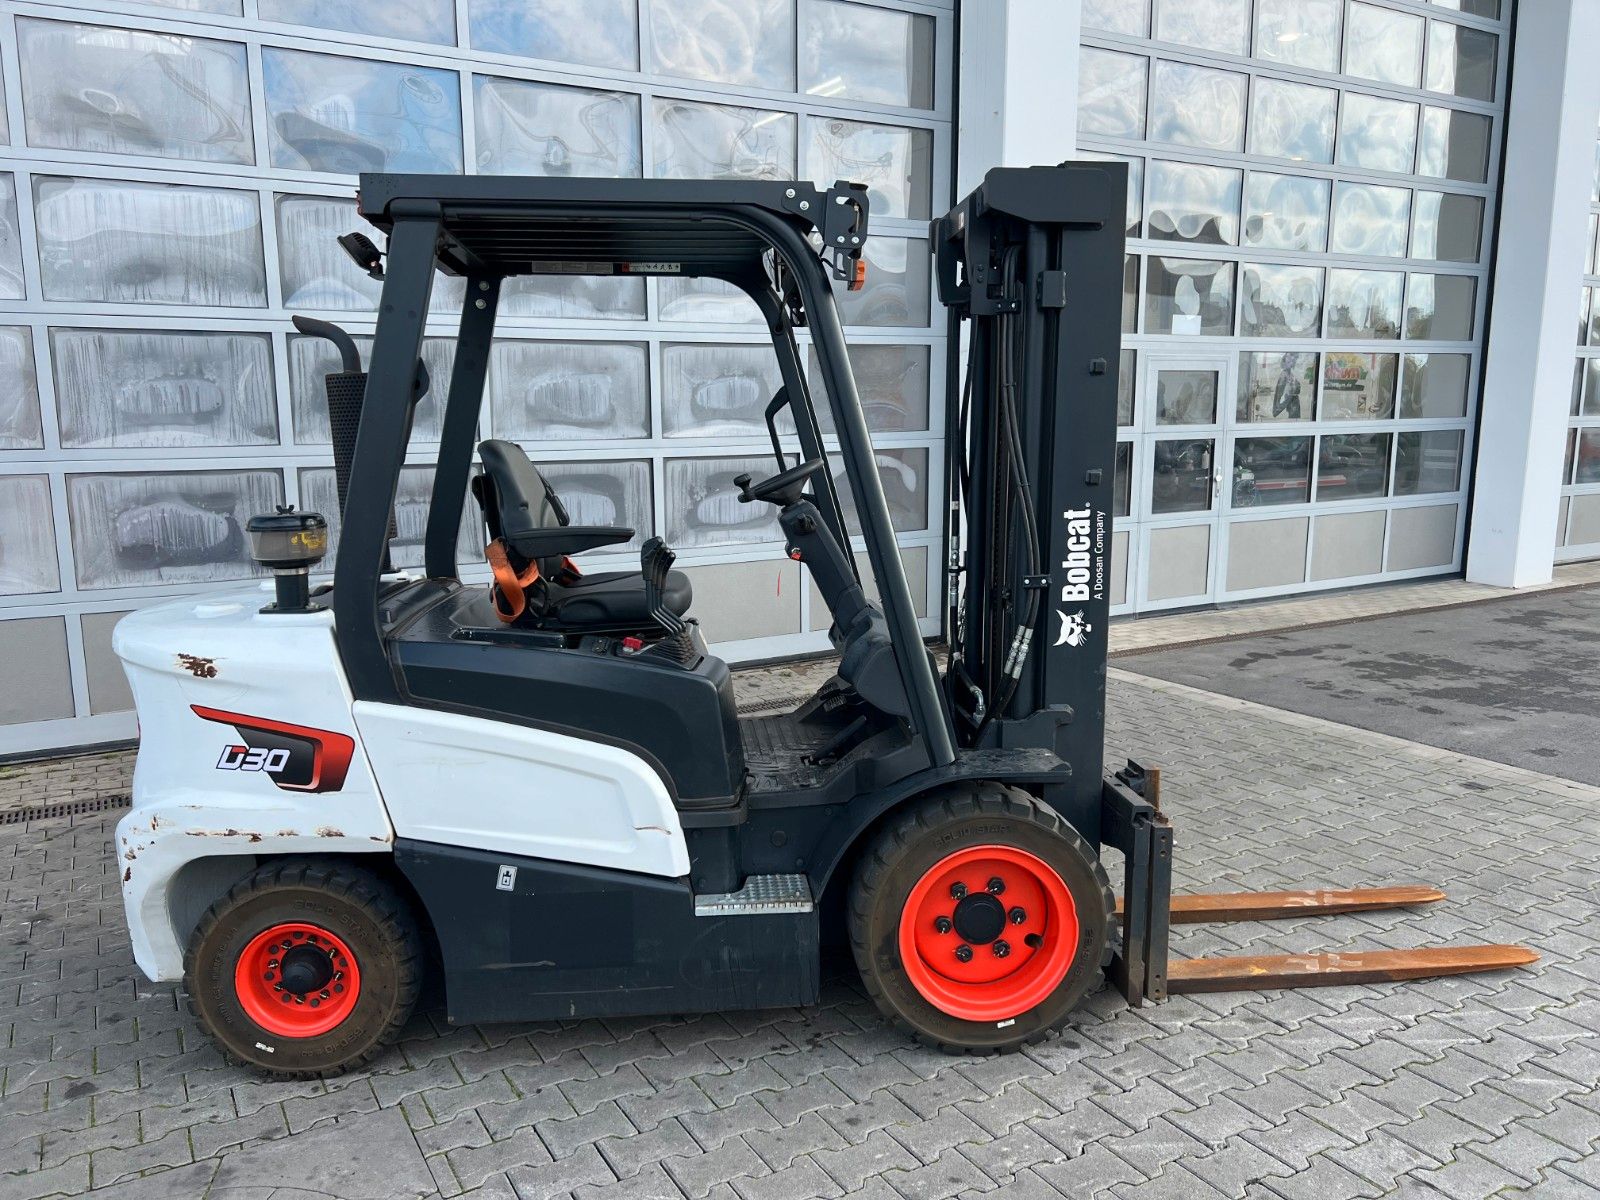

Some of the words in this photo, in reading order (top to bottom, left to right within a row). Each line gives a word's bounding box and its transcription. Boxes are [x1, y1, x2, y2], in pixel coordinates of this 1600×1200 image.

[1094, 510, 1106, 553] Company
[1061, 509, 1091, 602] Bobcat
[1093, 556, 1103, 589] Doosan
[216, 745, 291, 772] D30
